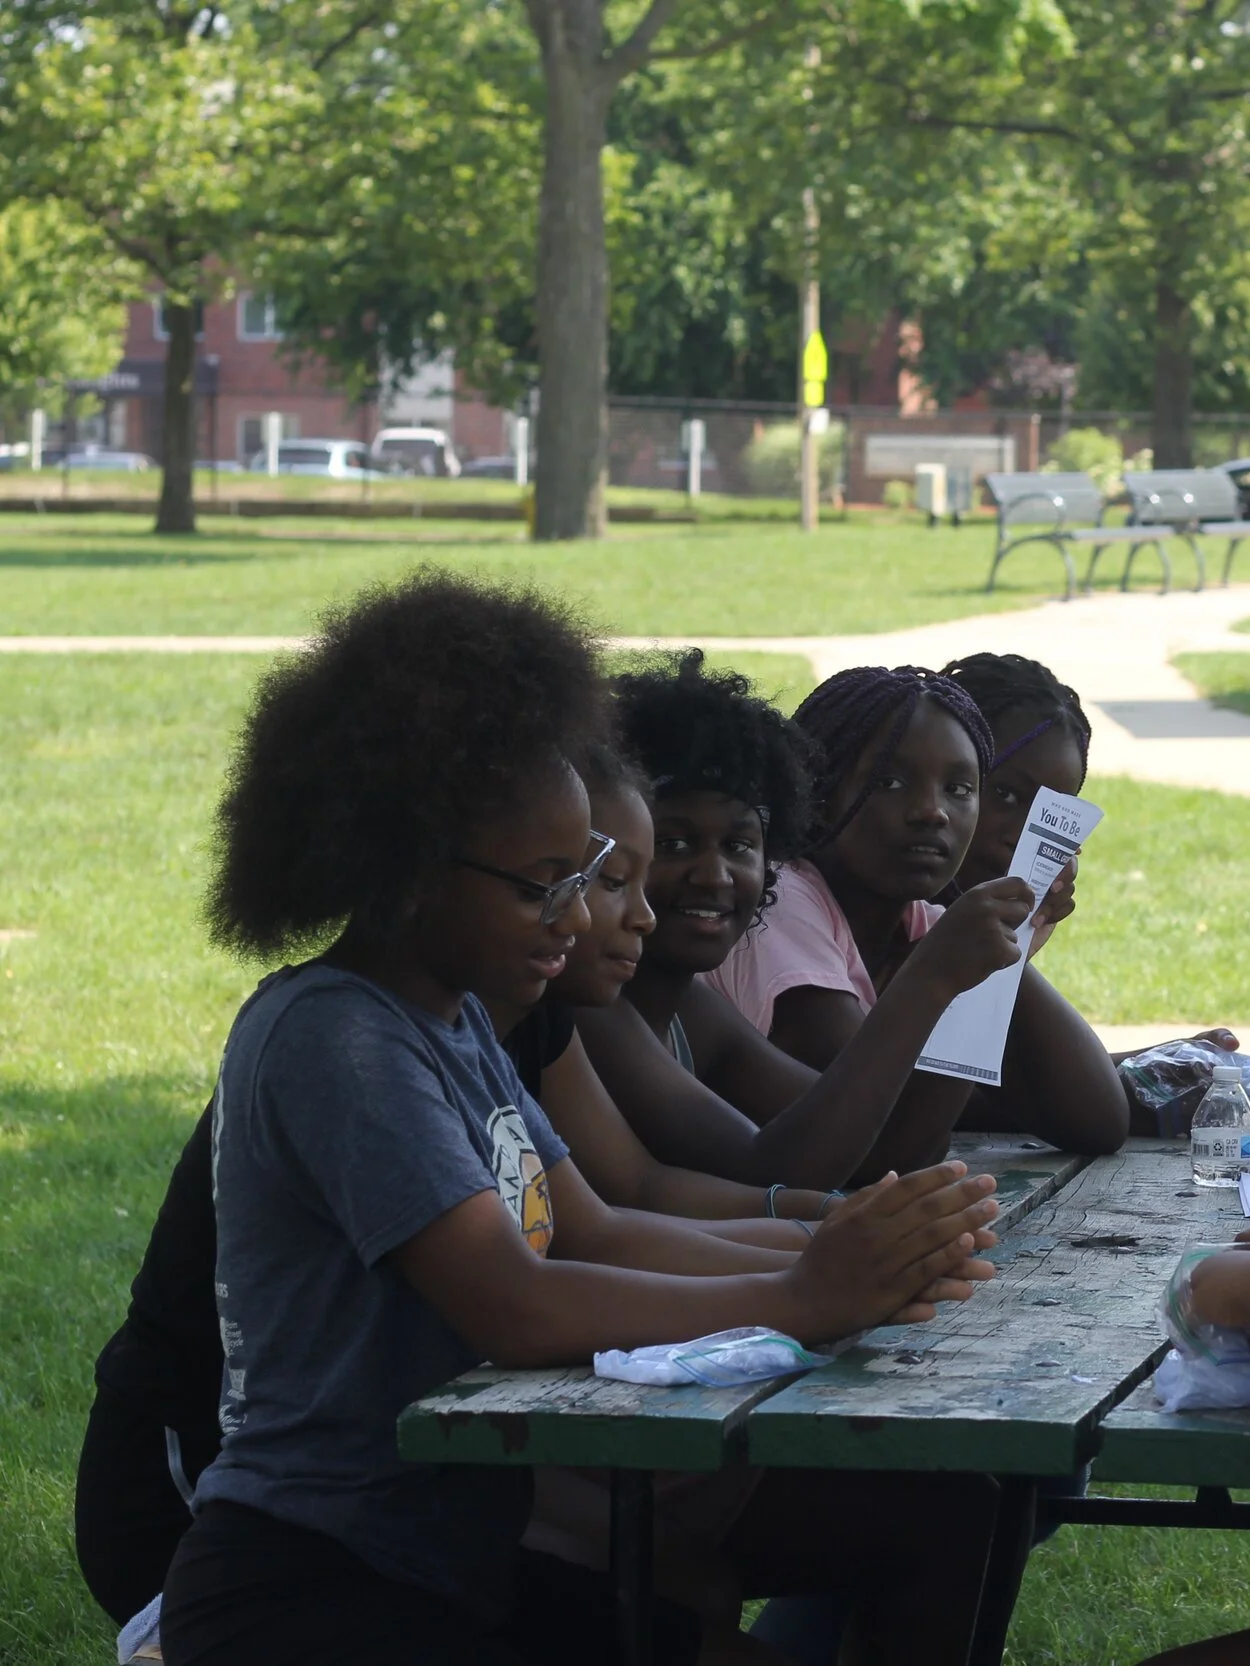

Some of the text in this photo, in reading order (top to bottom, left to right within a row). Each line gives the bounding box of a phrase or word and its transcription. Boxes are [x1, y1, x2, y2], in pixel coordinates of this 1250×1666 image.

[1040, 807, 1081, 837] You To Be
[1041, 846, 1062, 863] SMALL
